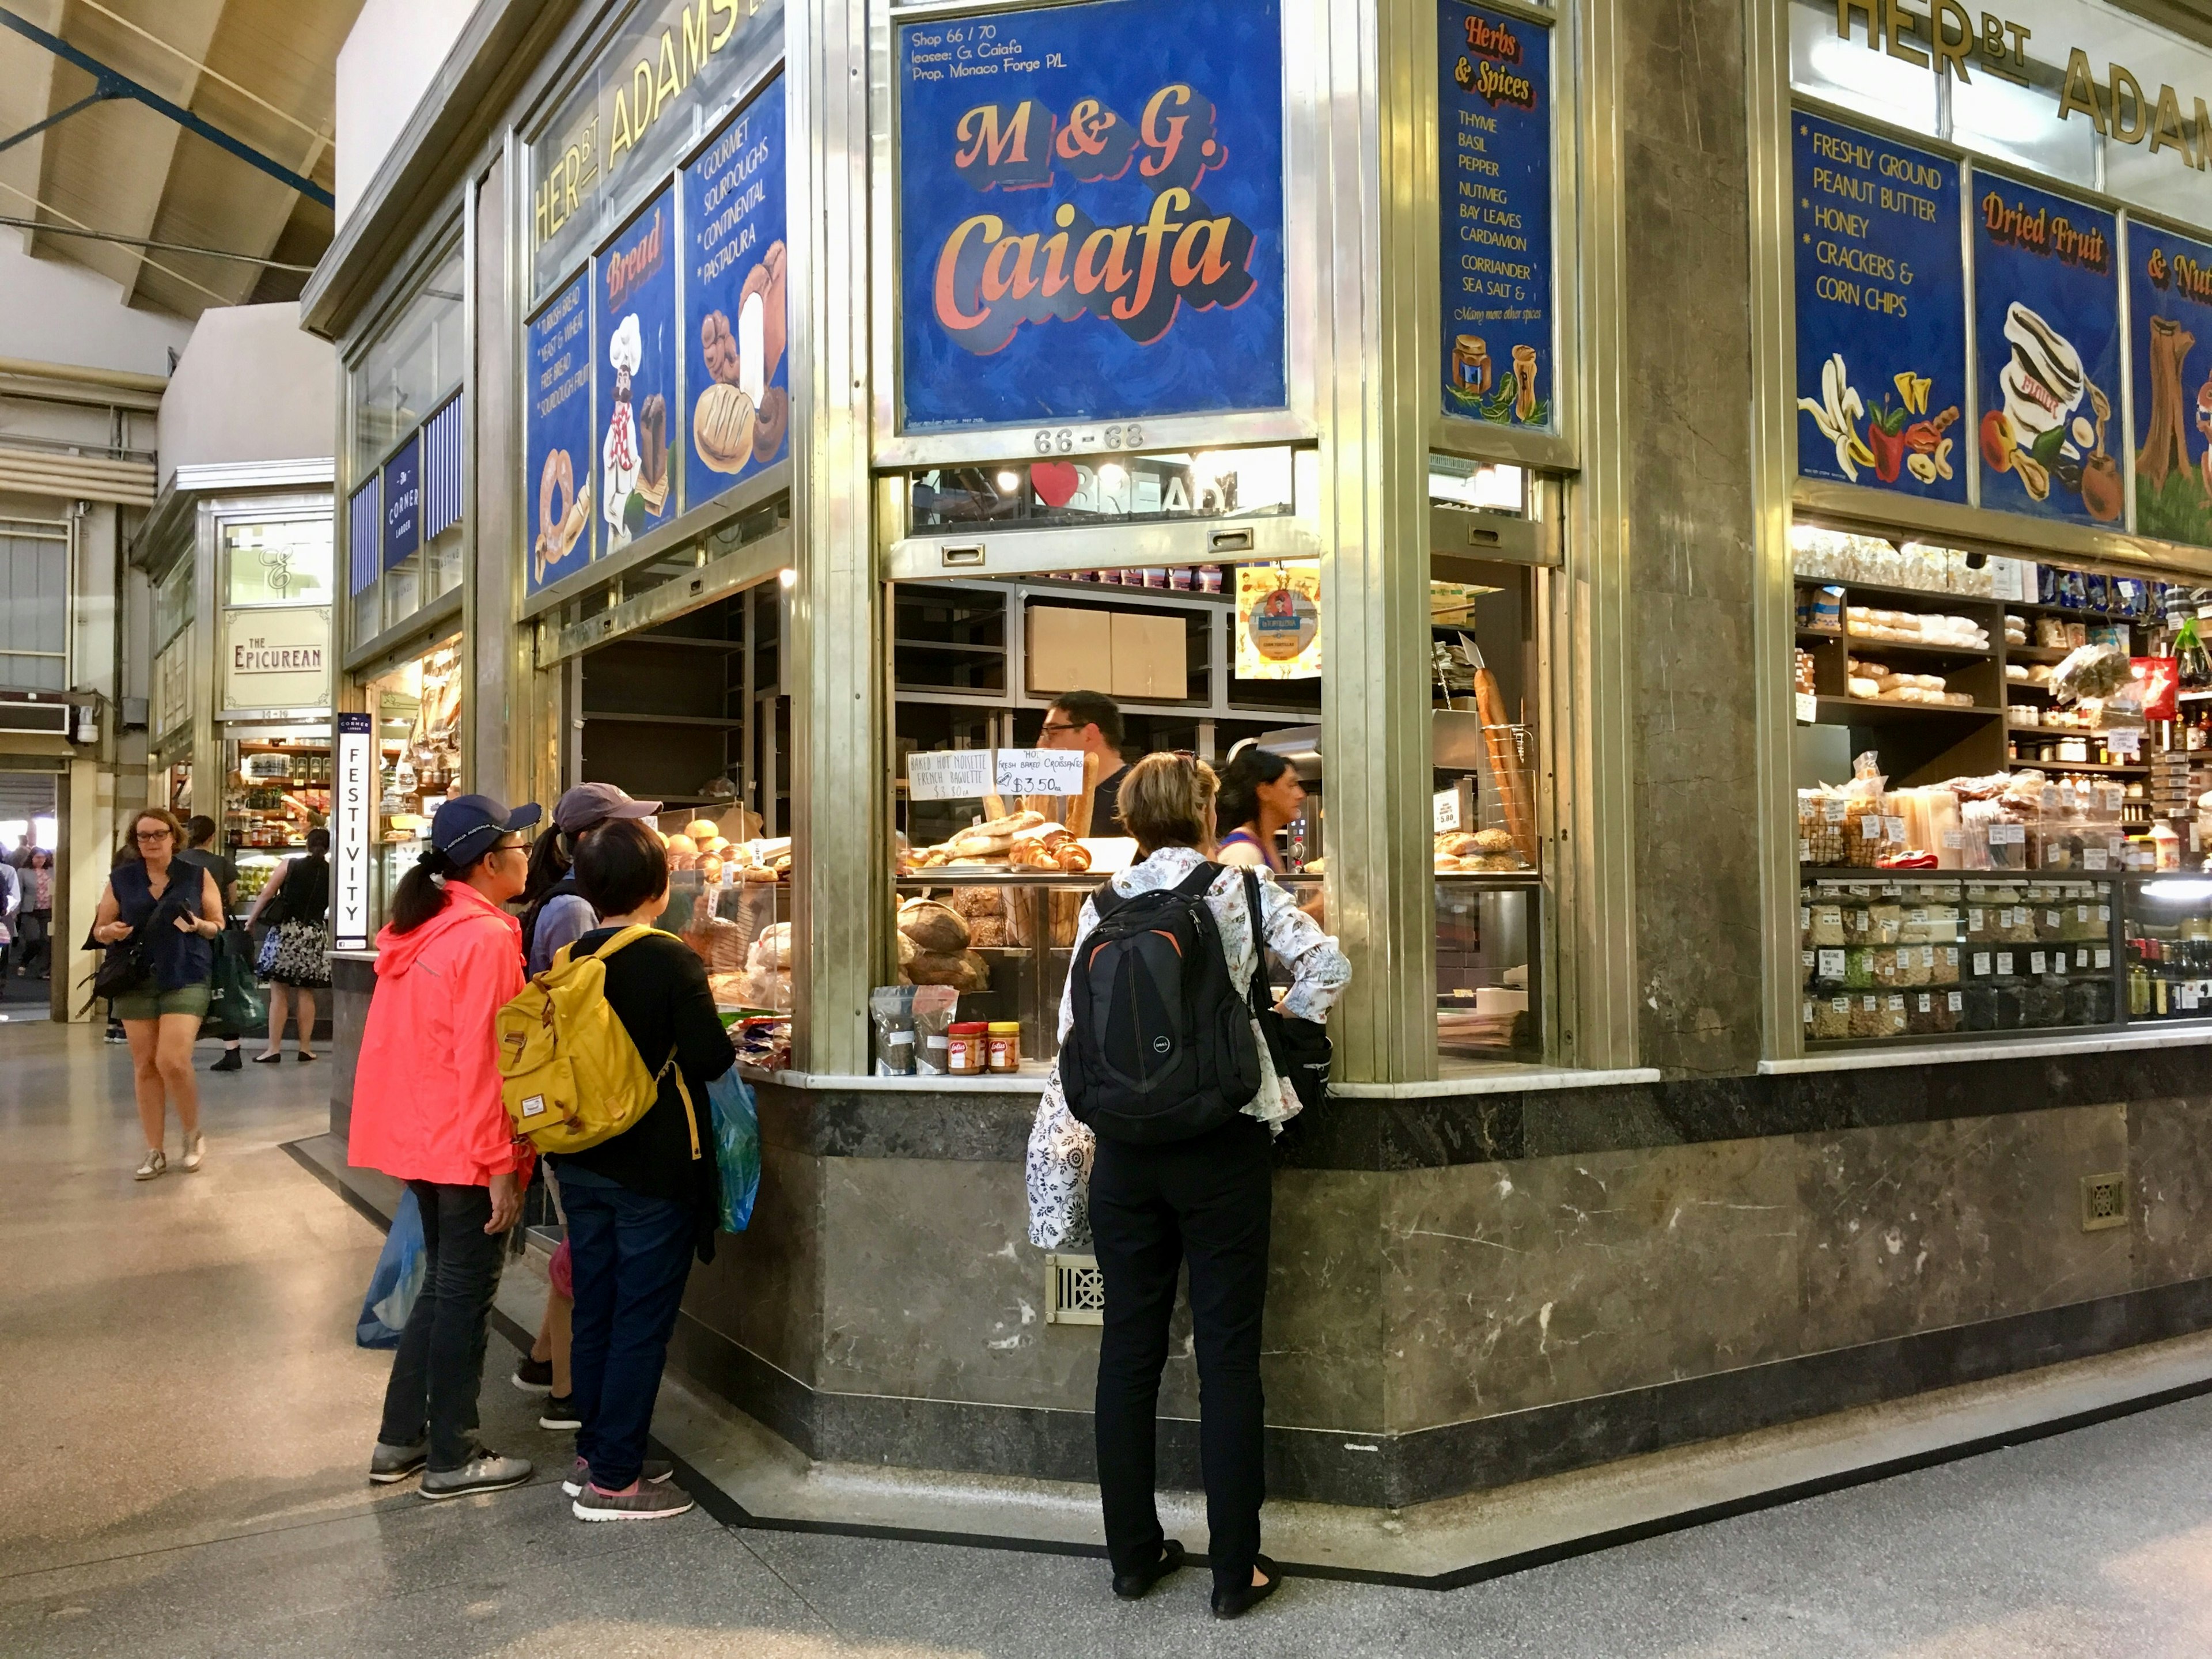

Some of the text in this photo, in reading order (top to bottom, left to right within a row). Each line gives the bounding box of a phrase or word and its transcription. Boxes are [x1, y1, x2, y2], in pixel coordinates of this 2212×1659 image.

[912, 32, 941, 47] Shop
[946, 28, 963, 43] 66
[978, 25, 996, 39] 70
[957, 45, 972, 60] G.
[978, 39, 1022, 58] Caiafa
[1465, 16, 1517, 56] Herbs
[912, 52, 1067, 81] Prop. Monaco Forge P/L
[1454, 56, 1530, 100] & Spices
[608, 0, 738, 174] ADAMS
[955, 84, 1218, 177] M & G.
[1459, 109, 1497, 134] THYME
[703, 116, 749, 181] GOURMET
[1459, 132, 1487, 153] BASIL
[1813, 132, 1941, 190] FRESHLY GROUND
[703, 136, 768, 217] SOURDOUGHS
[1459, 154, 1499, 177] PEPPER
[1459, 181, 1507, 205] NUTMEG
[1814, 167, 1936, 223] PEANUT BUTTER
[703, 179, 766, 251] CONTINENTAL
[1460, 203, 1522, 229] BAY LEAVES
[1815, 205, 1869, 238] HONEY
[1982, 191, 2104, 263] Dried Fruit
[606, 207, 661, 300] Bread
[703, 222, 756, 286] PASTADURA
[1460, 226, 1527, 252] CARDAMON
[934, 187, 1233, 331] Caiafa
[1461, 255, 1531, 281] CORRIANDER
[1816, 241, 1914, 285] CRACKERS &
[2147, 248, 2166, 279] &
[1463, 276, 1526, 301] SEA SALT &
[1816, 275, 1907, 317] CORN CHIPS
[541, 286, 580, 336] TURKISH BREAD
[1454, 306, 1484, 326] Many
[540, 309, 584, 364] YEAST & WHEAT
[540, 352, 571, 392] FREE BREAD
[540, 376, 574, 418] SOURDOUGH
[389, 488, 418, 525] CORNER
[396, 520, 411, 539] LARDER
[249, 638, 265, 649] THE
[911, 753, 987, 771] BAKED HOT NOISETTE
[917, 770, 982, 786] FRENCH BAGUETTE
[998, 760, 1016, 771] FRESH
[1021, 762, 1041, 770] BAKED
[345, 748, 359, 921] FESTIVITY
[448, 834, 467, 849] AUSTRALIA
[468, 824, 490, 835] AUSTRALIA
